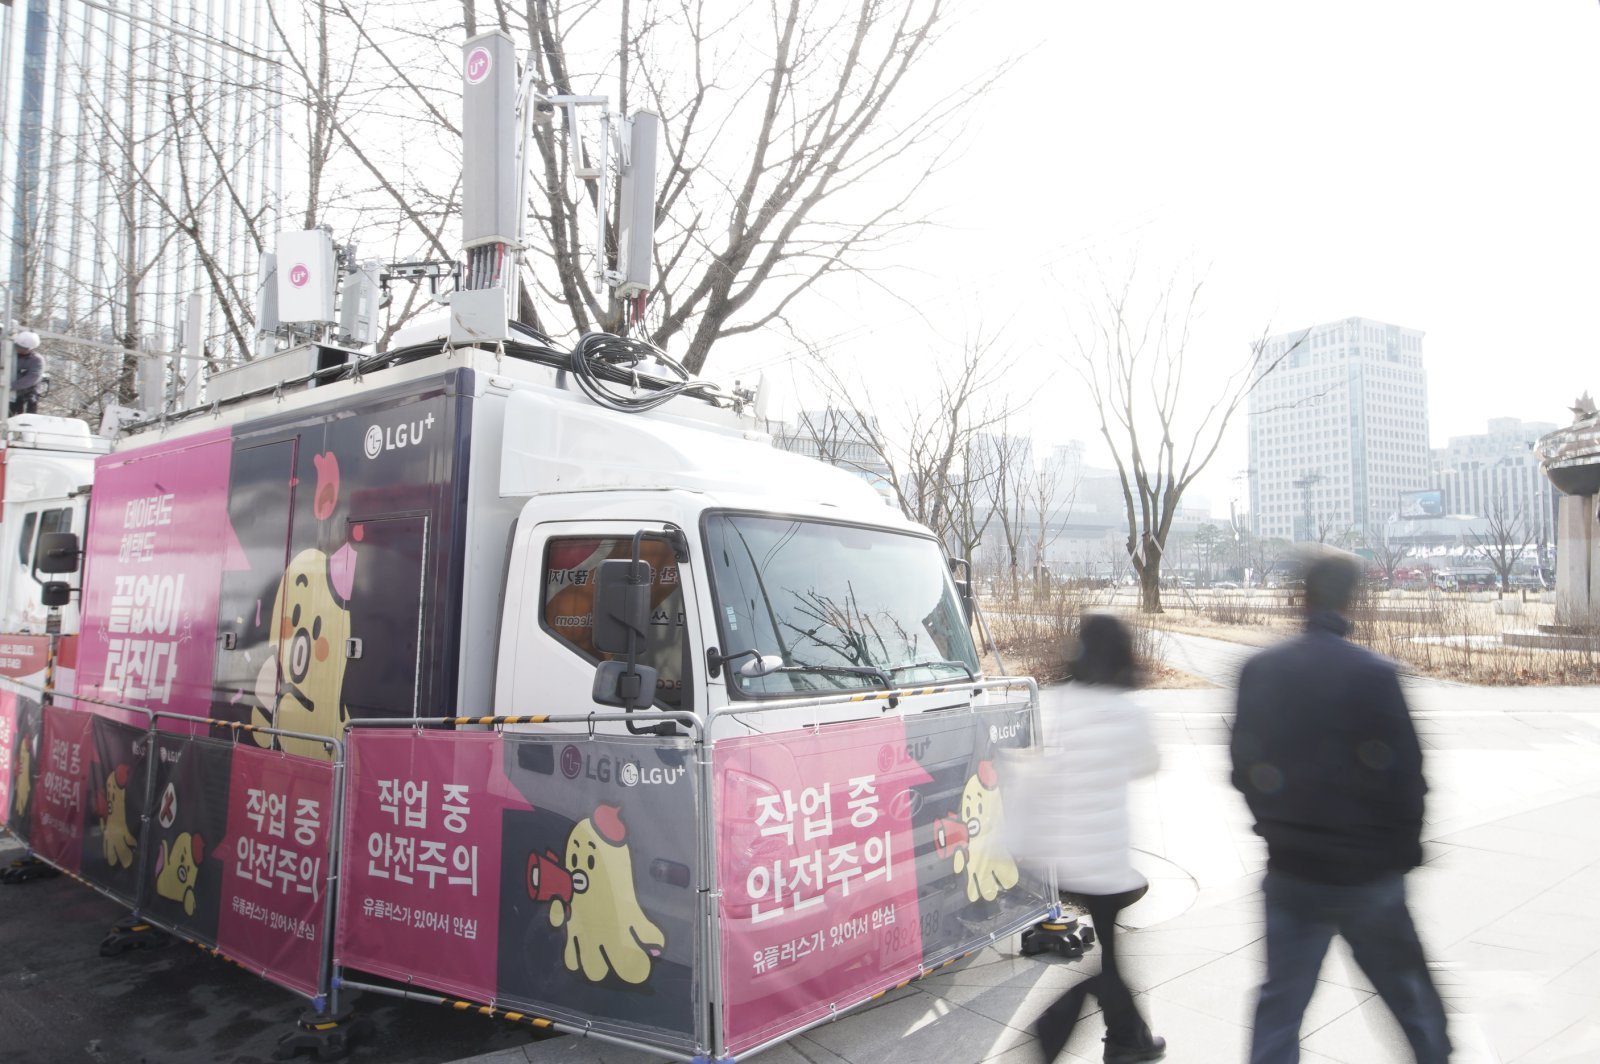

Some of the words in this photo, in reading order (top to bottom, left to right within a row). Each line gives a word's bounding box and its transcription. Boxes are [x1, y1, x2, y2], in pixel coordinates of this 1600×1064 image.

[124, 493, 175, 529] 데이터도
[108, 573, 184, 636] 끝없이
[102, 638, 178, 704] 터진다
[246, 788, 287, 839] 작업
[294, 798, 321, 846] 중
[377, 778, 428, 829] 작업
[442, 783, 470, 834] 중
[754, 782, 833, 846] 작업
[847, 774, 879, 828] 중
[236, 836, 321, 903] 안전주의
[367, 831, 478, 896] 안전주의
[746, 830, 892, 924] 안전주의
[231, 896, 268, 926] 유플러스가
[270, 911, 297, 936] 있어서
[363, 896, 411, 927] 유플러스가
[414, 909, 449, 934] 있어서
[453, 916, 478, 940] 안심
[752, 929, 825, 975] 유플러스가
[829, 914, 868, 948] 있어서
[871, 903, 896, 929] 안심
